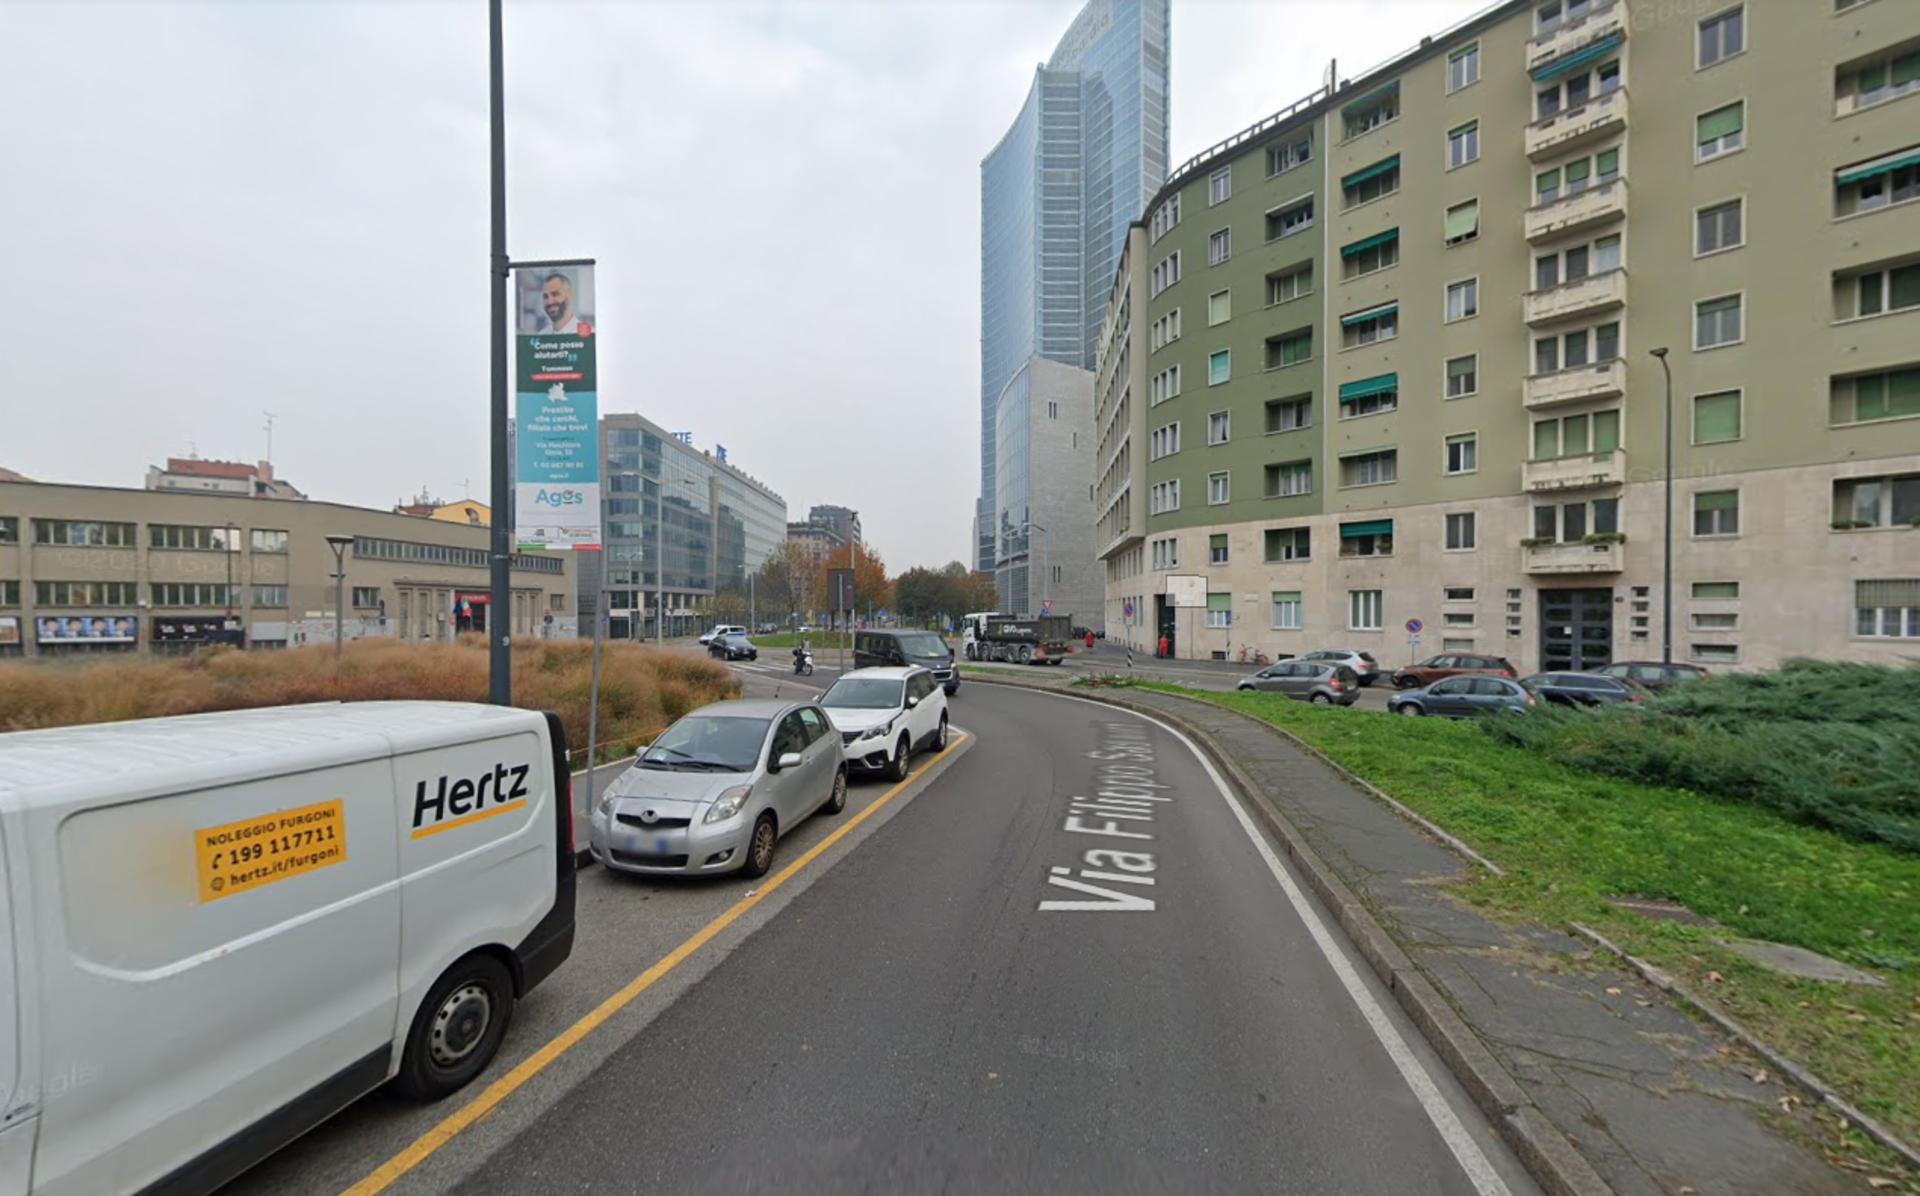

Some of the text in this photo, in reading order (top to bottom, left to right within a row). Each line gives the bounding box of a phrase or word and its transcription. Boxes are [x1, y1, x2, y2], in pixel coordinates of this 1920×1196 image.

[560, 341, 584, 350] posso
[535, 488, 583, 507] Agos
[411, 762, 529, 828] Hertz
[206, 808, 336, 847] NOLEGGIO FURGONI
[230, 825, 336, 866] 199 117711
[230, 844, 340, 886] hertz.it/furgoni
